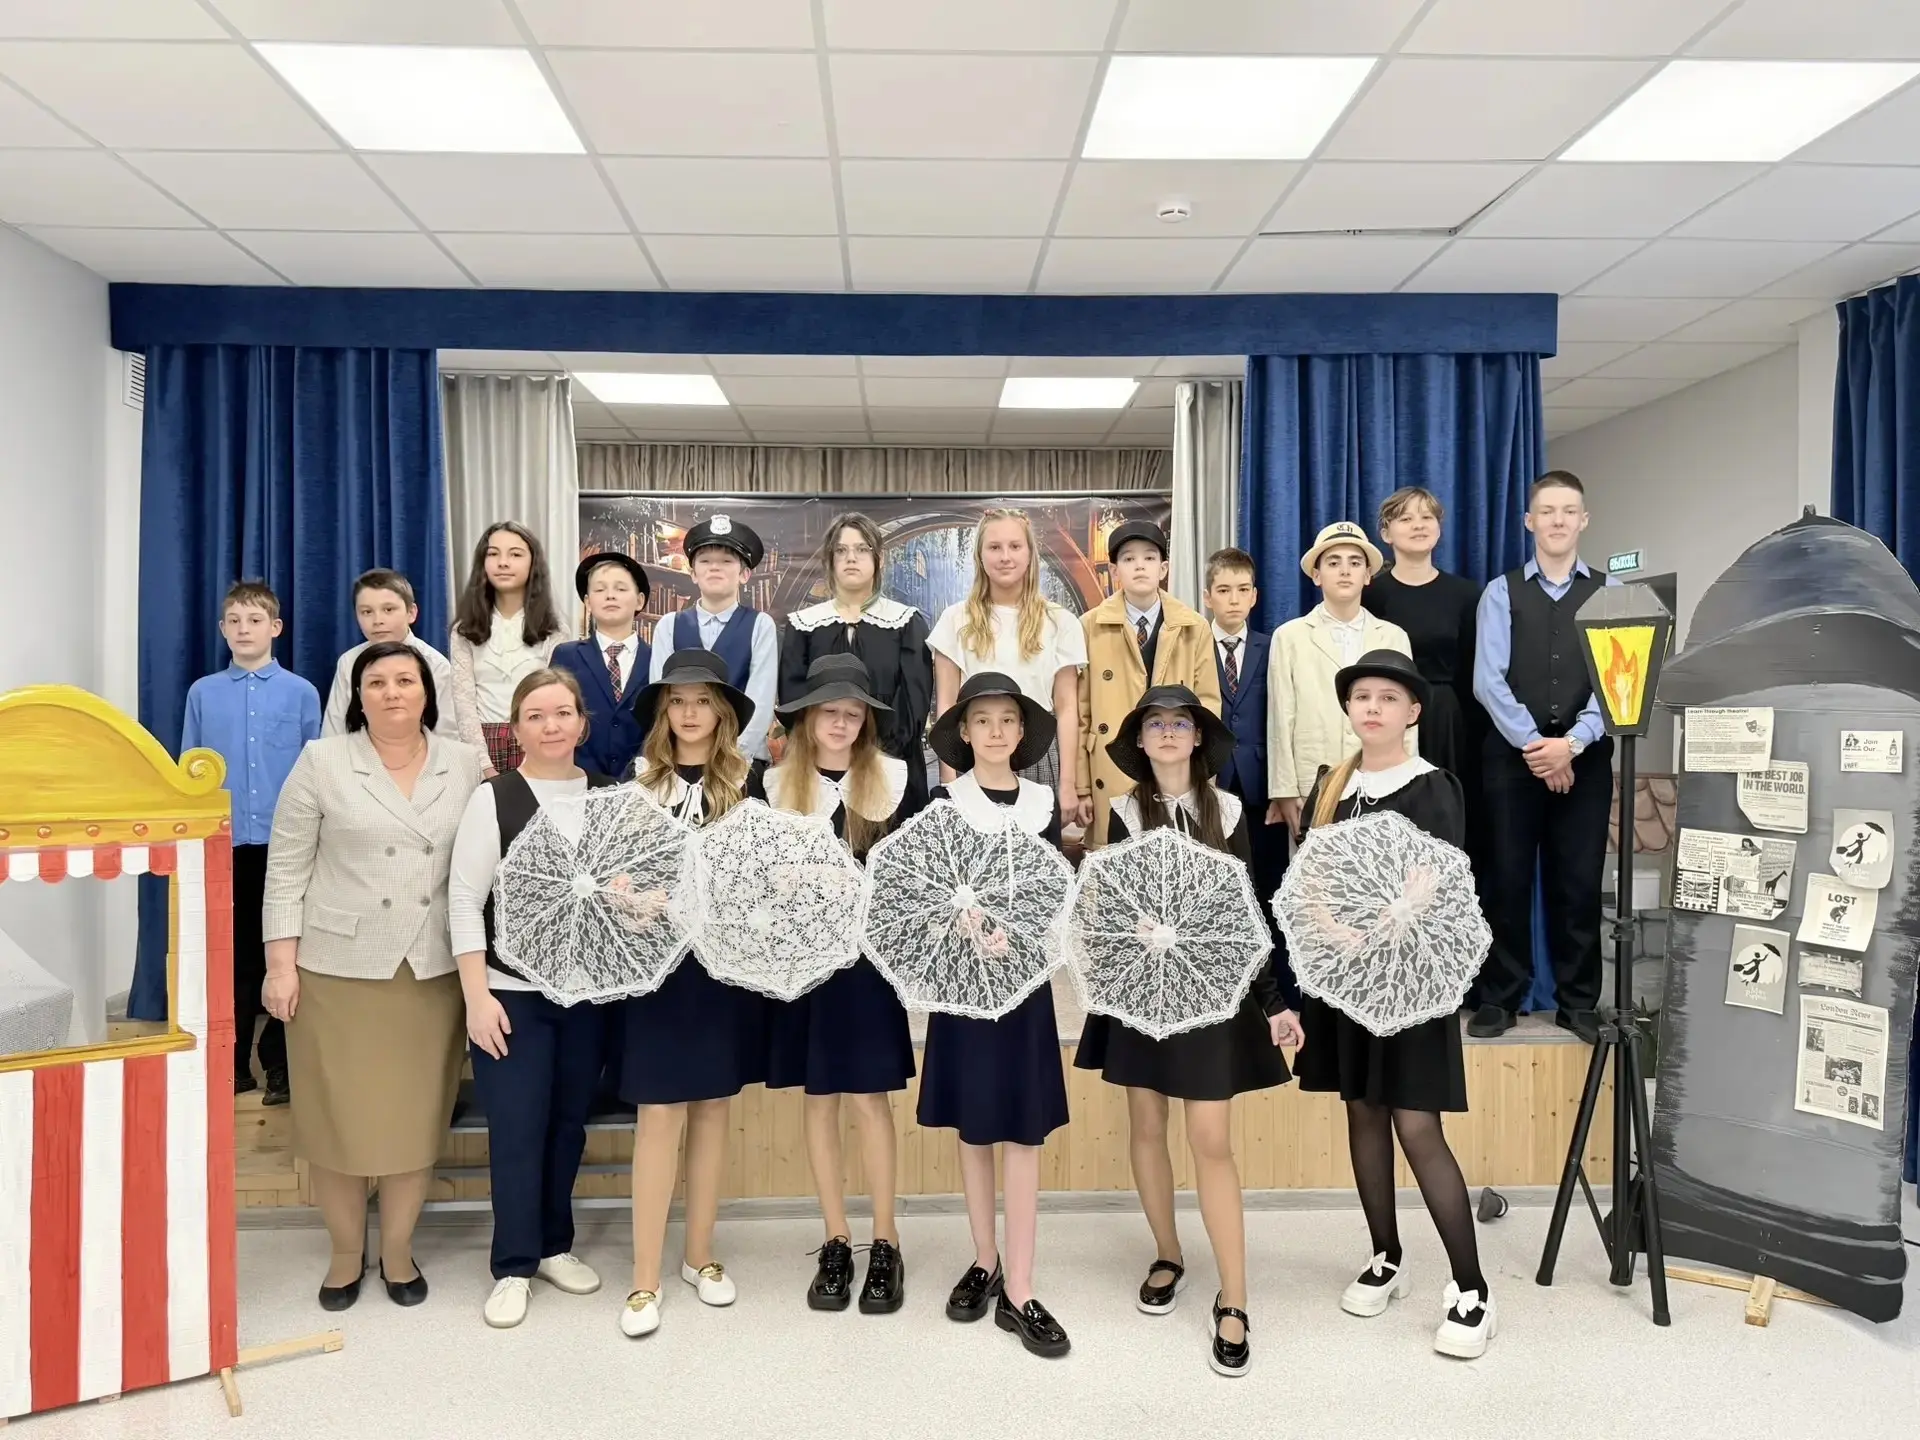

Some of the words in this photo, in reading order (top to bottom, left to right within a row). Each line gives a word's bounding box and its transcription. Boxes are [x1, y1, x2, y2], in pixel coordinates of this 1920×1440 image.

[1609, 553, 1637, 571] ВЫХОД
[1764, 770, 1787, 781] BEST
[1789, 771, 1804, 782] JOB
[1742, 779, 1753, 790] IN
[1755, 781, 1772, 792] THE
[1773, 782, 1805, 795] WORLD.
[1827, 893, 1857, 905] LOST
[1820, 1003, 1849, 1015] London
[1850, 1008, 1871, 1019] News
